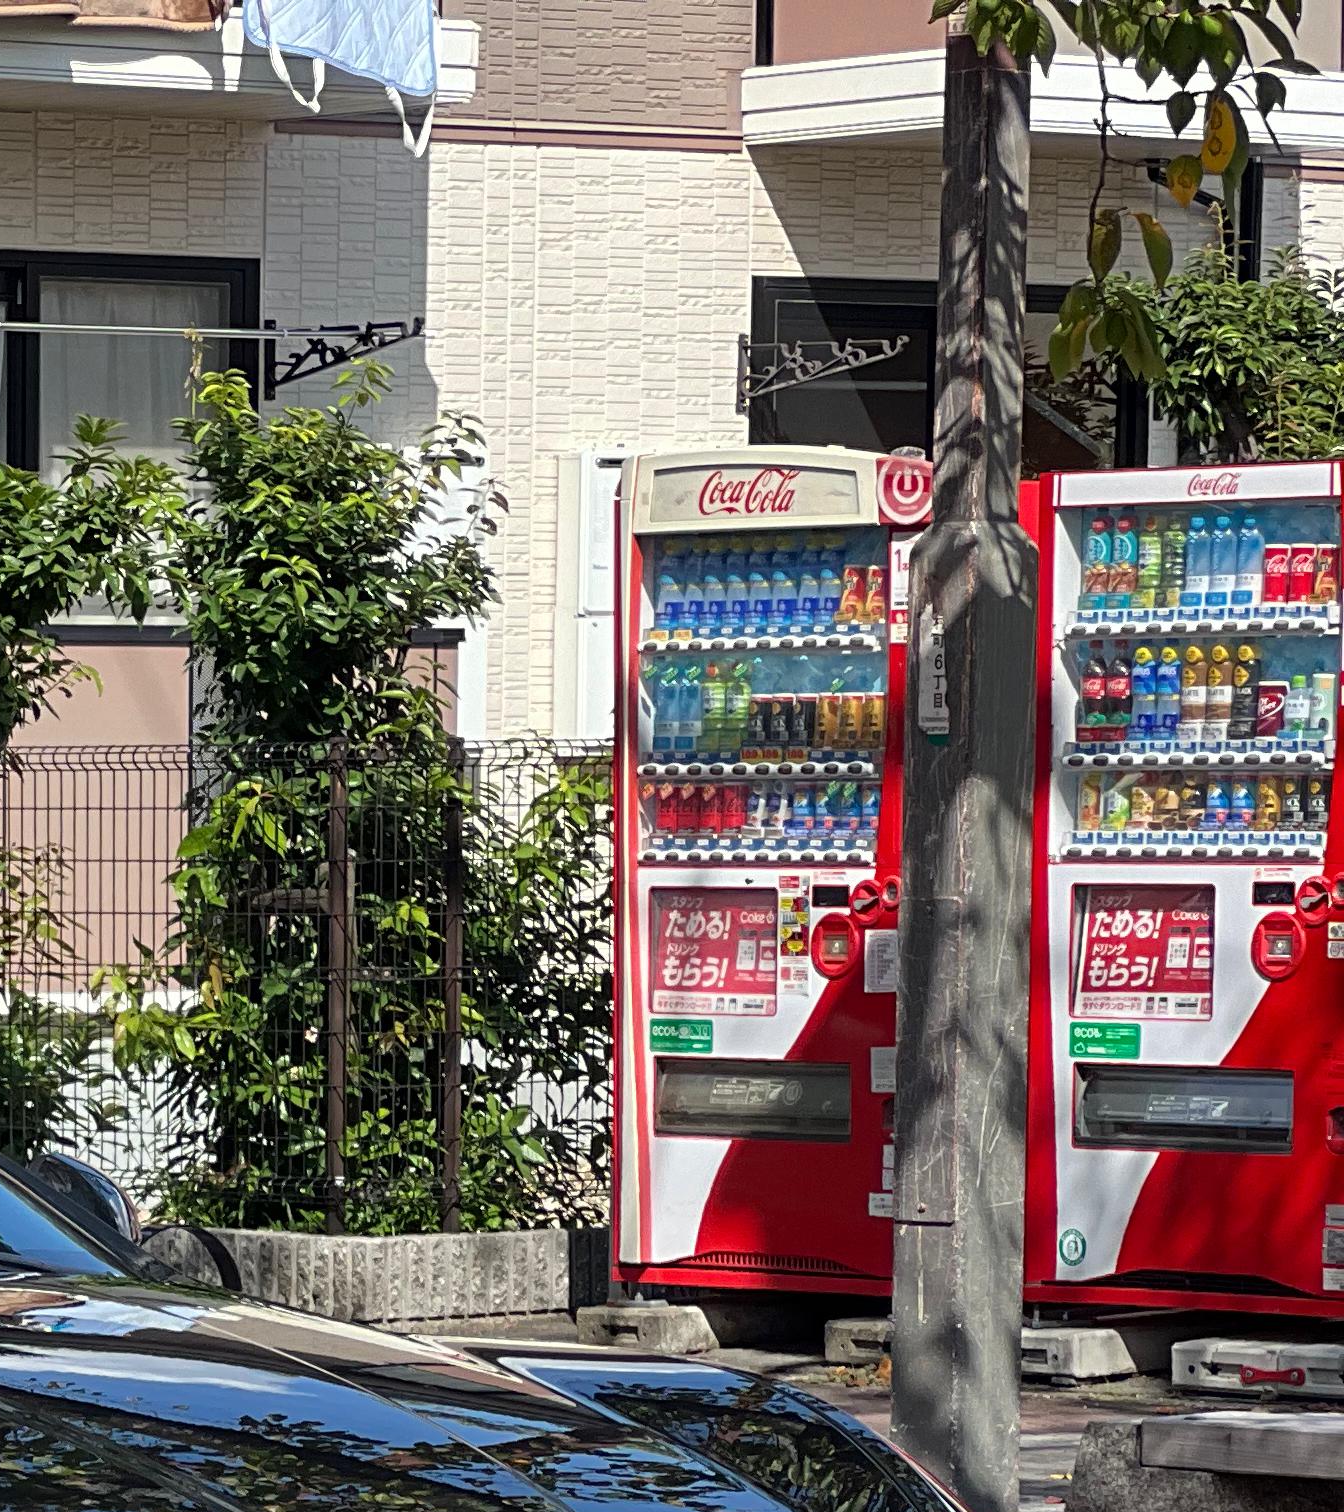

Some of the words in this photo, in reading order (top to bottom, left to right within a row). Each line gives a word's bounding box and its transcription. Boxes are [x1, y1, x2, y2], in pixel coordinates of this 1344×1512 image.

[698, 467, 801, 515] Coca-Cola
[1187, 472, 1242, 497] Coca-Cola
[1092, 943, 1127, 956] ドリンク
